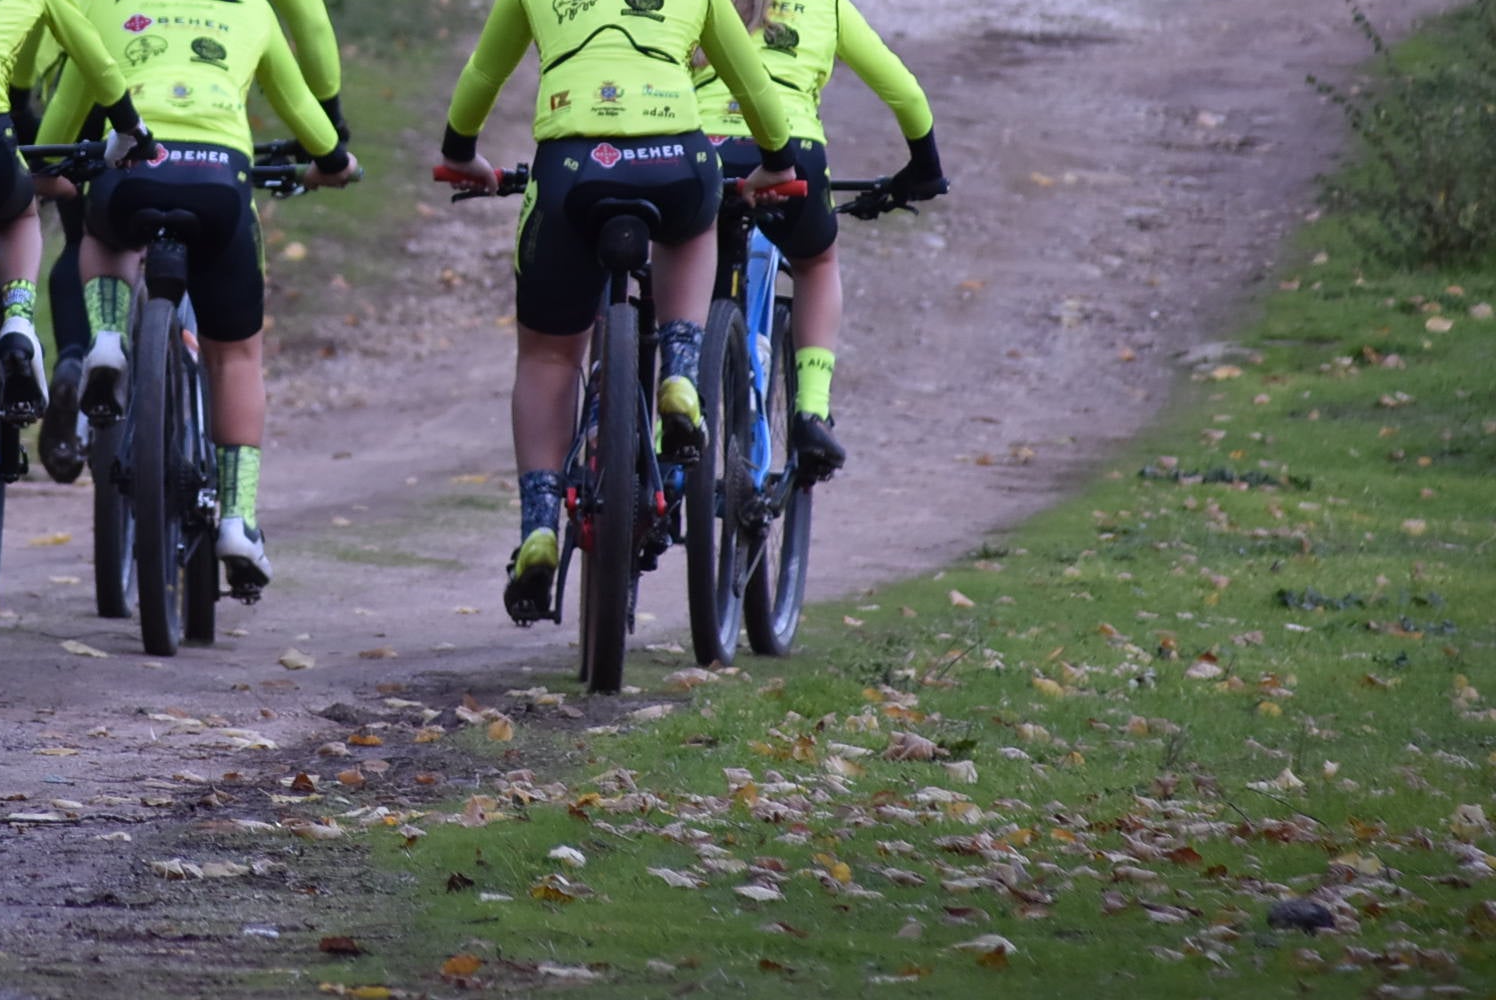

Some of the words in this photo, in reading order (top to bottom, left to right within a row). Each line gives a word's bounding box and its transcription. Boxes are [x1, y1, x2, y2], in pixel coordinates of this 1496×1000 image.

[158, 16, 229, 32] BEHER
[170, 150, 230, 163] BEHER
[623, 144, 685, 160] BEHER
